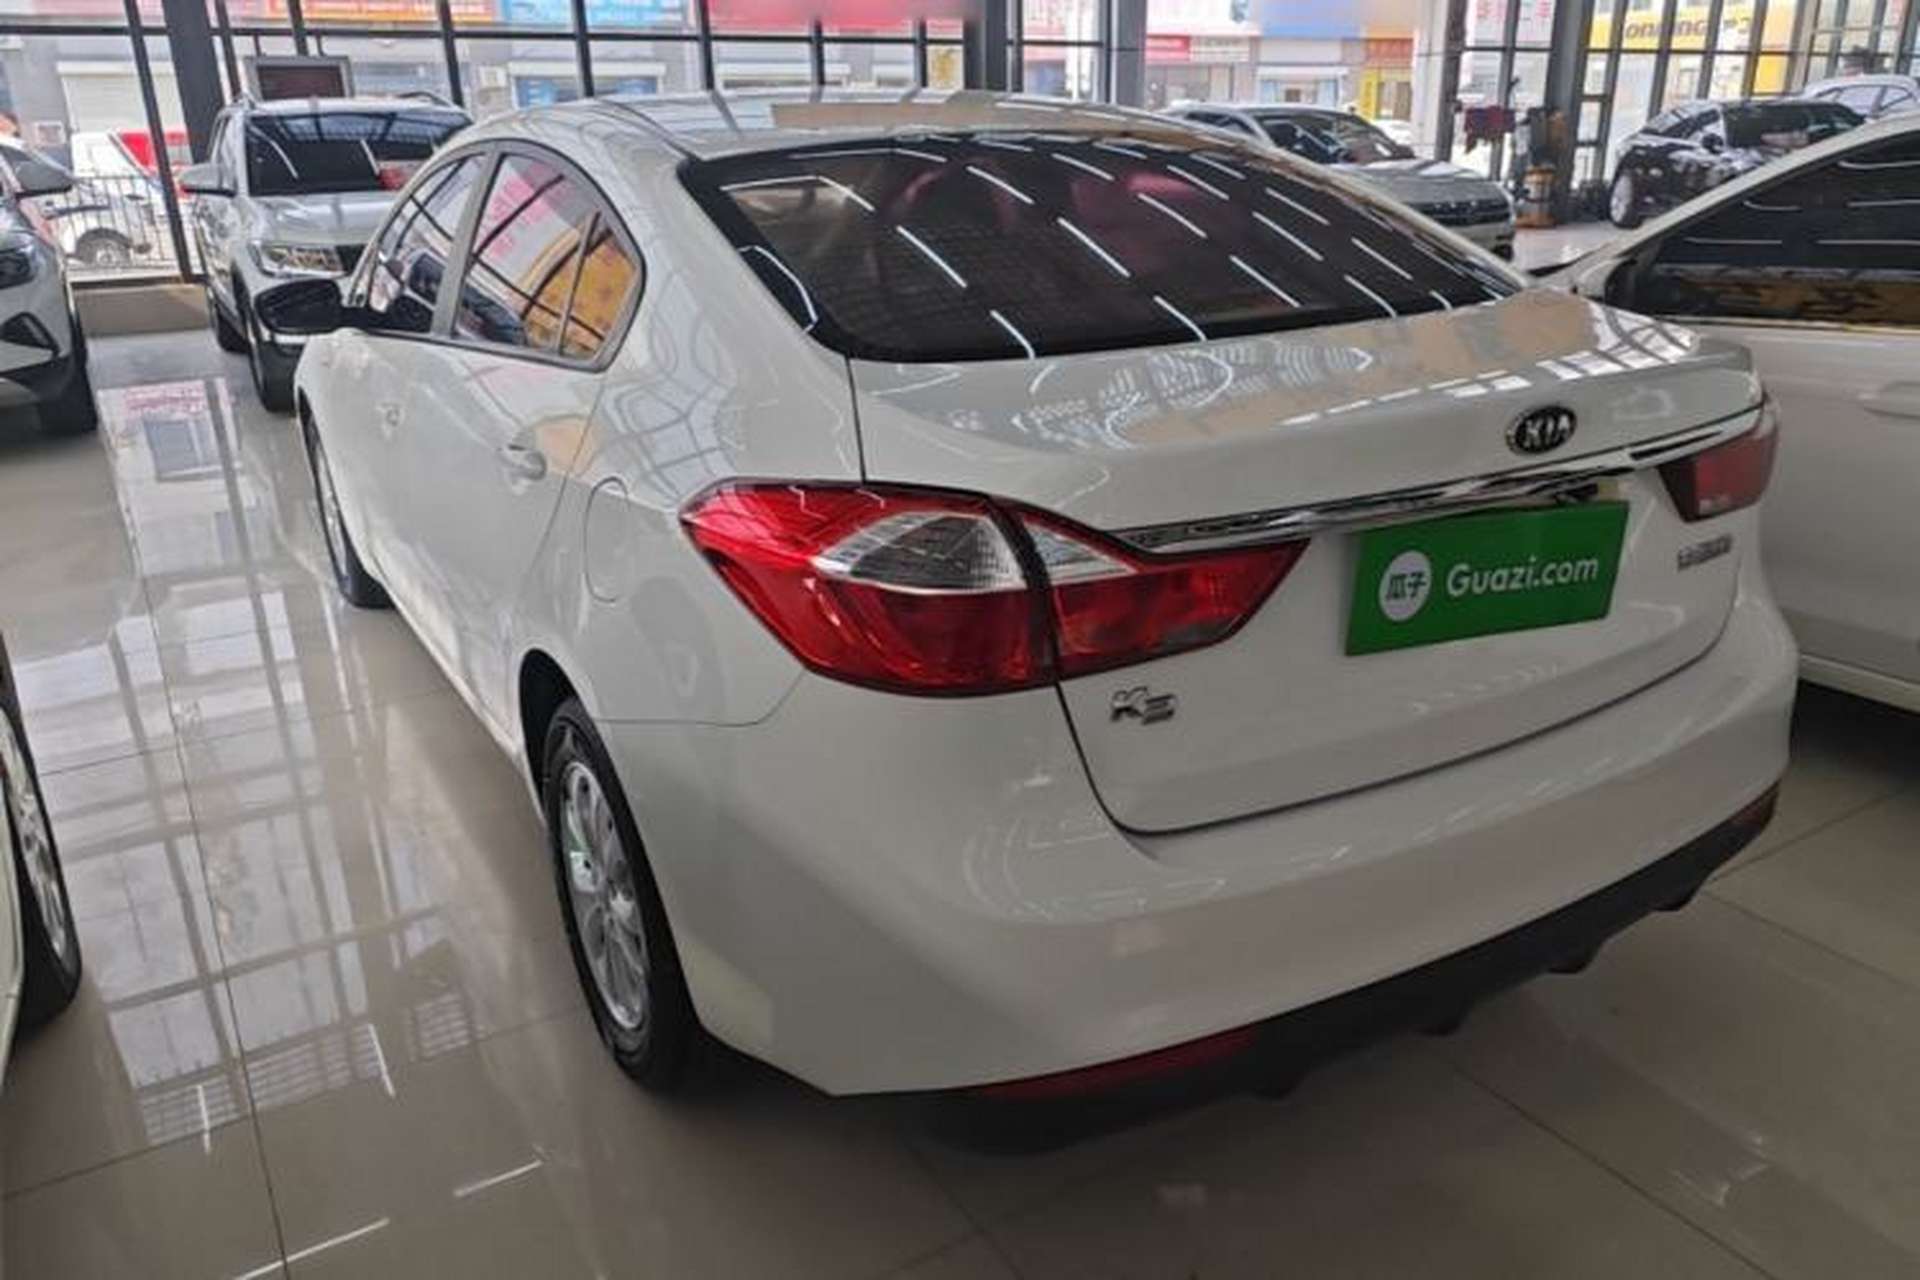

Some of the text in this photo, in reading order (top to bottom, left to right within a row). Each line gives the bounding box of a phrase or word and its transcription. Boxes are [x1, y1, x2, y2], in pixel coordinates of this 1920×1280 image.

[1523, 414, 1571, 448] KIA
[1387, 571, 1427, 600] 瓜子
[1447, 554, 1599, 598] Guazi.com
